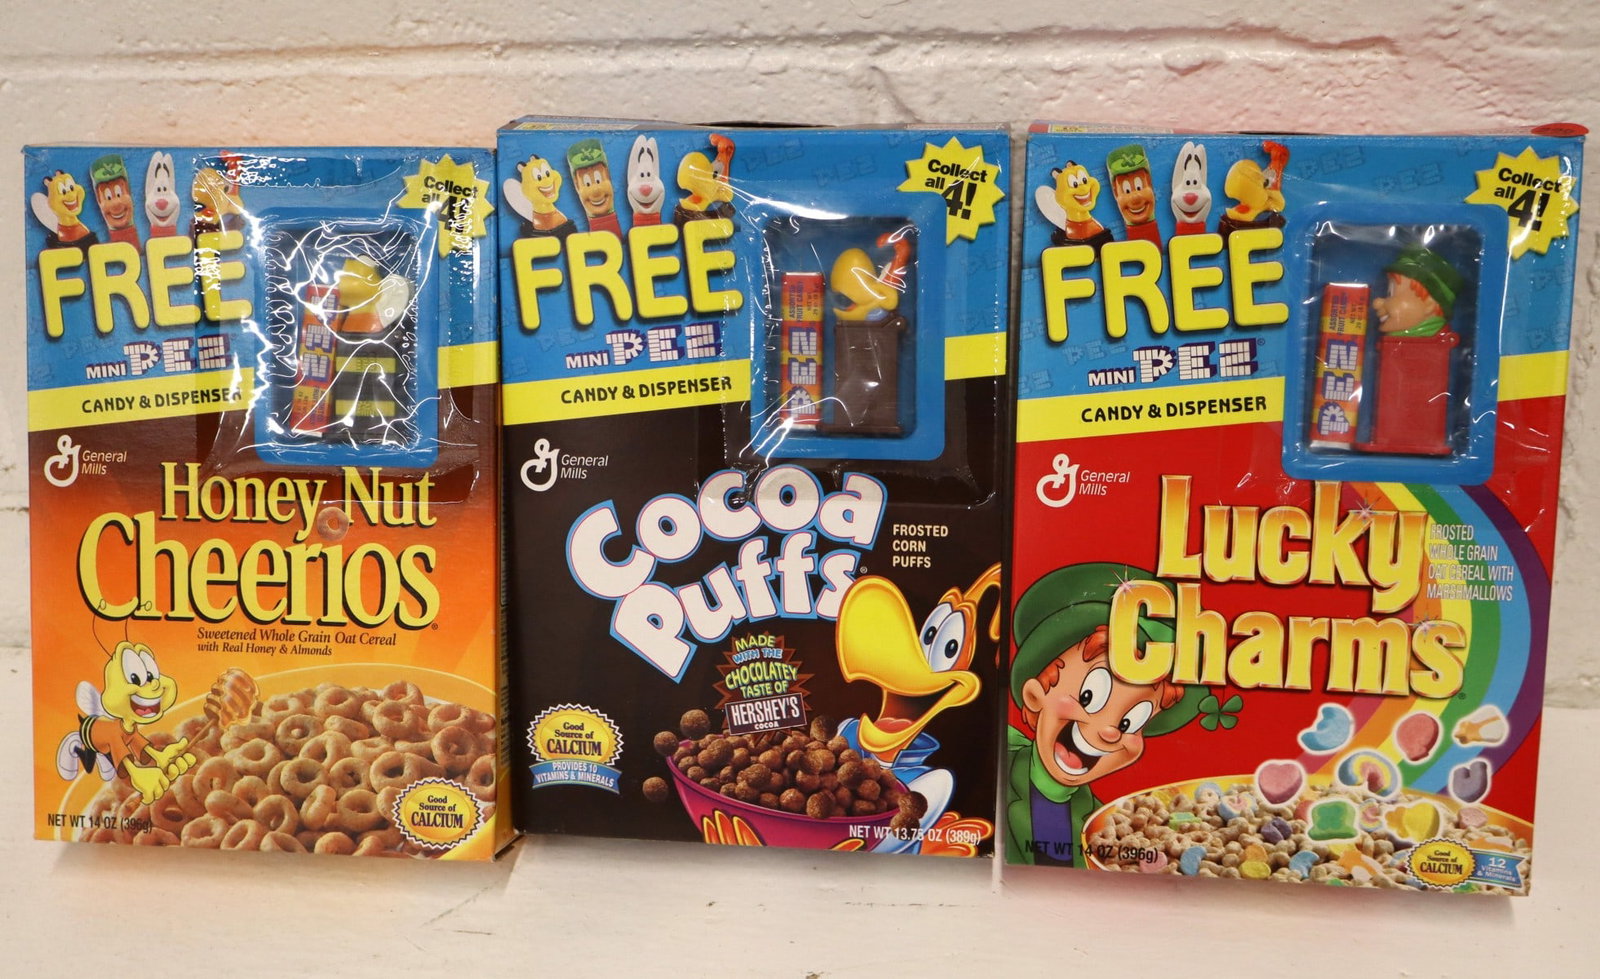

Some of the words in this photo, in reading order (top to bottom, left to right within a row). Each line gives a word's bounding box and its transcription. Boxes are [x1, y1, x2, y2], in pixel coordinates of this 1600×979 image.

[928, 159, 987, 183] Collect
[1498, 167, 1562, 193] Collect
[424, 176, 478, 198] Collect
[925, 176, 945, 190] all
[942, 180, 978, 220] 4!
[1494, 186, 1516, 199] all
[1507, 190, 1550, 232] 4!
[512, 218, 744, 330] FREE
[39, 230, 253, 338] FREE
[1041, 227, 1290, 343] FREE
[565, 351, 610, 369] MINI
[605, 321, 722, 365] PEZ
[85, 362, 128, 380] MINI
[123, 333, 231, 376] PEZ
[1088, 367, 1137, 386] MINI
[1132, 338, 1259, 383] PEZ
[561, 386, 618, 404] CANDY
[622, 386, 635, 399] &
[639, 376, 732, 398] DISPENSER
[1318, 339, 1358, 435] PEZ
[82, 396, 135, 413] CANDY
[139, 395, 151, 408] &
[155, 387, 242, 408] DISPENSER
[1082, 405, 1143, 422] CANDY
[1148, 404, 1161, 418] &
[1166, 396, 1267, 417] DISPENSER
[82, 450, 127, 462] General
[561, 454, 608, 466] General
[81, 463, 107, 475] Mills
[560, 467, 587, 479] Mills
[1080, 469, 1130, 483] General
[1079, 483, 1107, 496] Mills
[160, 462, 327, 541] Honey
[341, 465, 438, 528] Nut
[566, 465, 888, 600] Cocoa
[892, 524, 949, 537] FROSTED
[1430, 524, 1474, 540] FROSTED
[892, 540, 926, 552] CORN
[1157, 474, 1429, 614] Lucky
[1429, 544, 1465, 560] WHOLE
[1467, 545, 1498, 561] GRAIN
[892, 555, 931, 568] PUFFS
[77, 511, 441, 631] Cheerios
[1428, 564, 1447, 579] OAT
[1450, 564, 1486, 580] CEREAL
[1488, 565, 1514, 581] WITH
[1427, 583, 1513, 601] MARSHMALLOWS
[610, 532, 861, 684] Puffs
[197, 627, 256, 641] Sweetened
[260, 628, 295, 642] Whole
[298, 630, 331, 643] Grain
[335, 632, 356, 645] Oat
[360, 632, 396, 646] Cereal
[735, 635, 776, 652] MADE
[1108, 577, 1467, 699] Charms
[198, 642, 219, 652] with
[222, 642, 243, 653] Real
[246, 643, 277, 656] Honey
[280, 645, 289, 654] &
[290, 645, 332, 656] Almonds
[732, 648, 760, 664] WITH
[761, 648, 783, 659] THE
[725, 661, 798, 689] CHOCOLATEY
[740, 682, 773, 698] TASTE
[774, 680, 789, 693] OF
[731, 696, 800, 726] HERSHEY'S
[554, 730, 583, 739] Source
[585, 731, 594, 739] of
[563, 722, 584, 731] Good
[754, 721, 779, 730] COCOA
[547, 739, 602, 756] CALCIUM
[552, 762, 587, 772] PROVIDES
[589, 764, 598, 773] 10
[535, 771, 569, 784] VITAMINS
[570, 771, 575, 780] &
[578, 772, 614, 788] MINERALS
[419, 803, 446, 811] Source
[427, 795, 448, 803] Good
[48, 813, 66, 826] NET
[69, 814, 85, 828] WT
[89, 816, 100, 828] 14
[104, 816, 117, 829] OZ
[121, 817, 153, 833] (396g)
[411, 811, 464, 828] CALCIUM
[849, 825, 870, 838] NET
[874, 826, 892, 839] WT
[895, 827, 923, 840] 13.75
[928, 828, 942, 842] OZ
[946, 829, 981, 845] (389g)
[1025, 840, 1049, 853] NET
[1054, 841, 1073, 855] WT
[1078, 844, 1092, 856] 14
[1097, 845, 1113, 858] OZ
[1118, 845, 1158, 863] (396g)
[1420, 862, 1463, 875] CALCIUM
[1481, 865, 1512, 876] Vitamins
[1489, 857, 1506, 868] 12
[1485, 872, 1516, 882] Minerals
